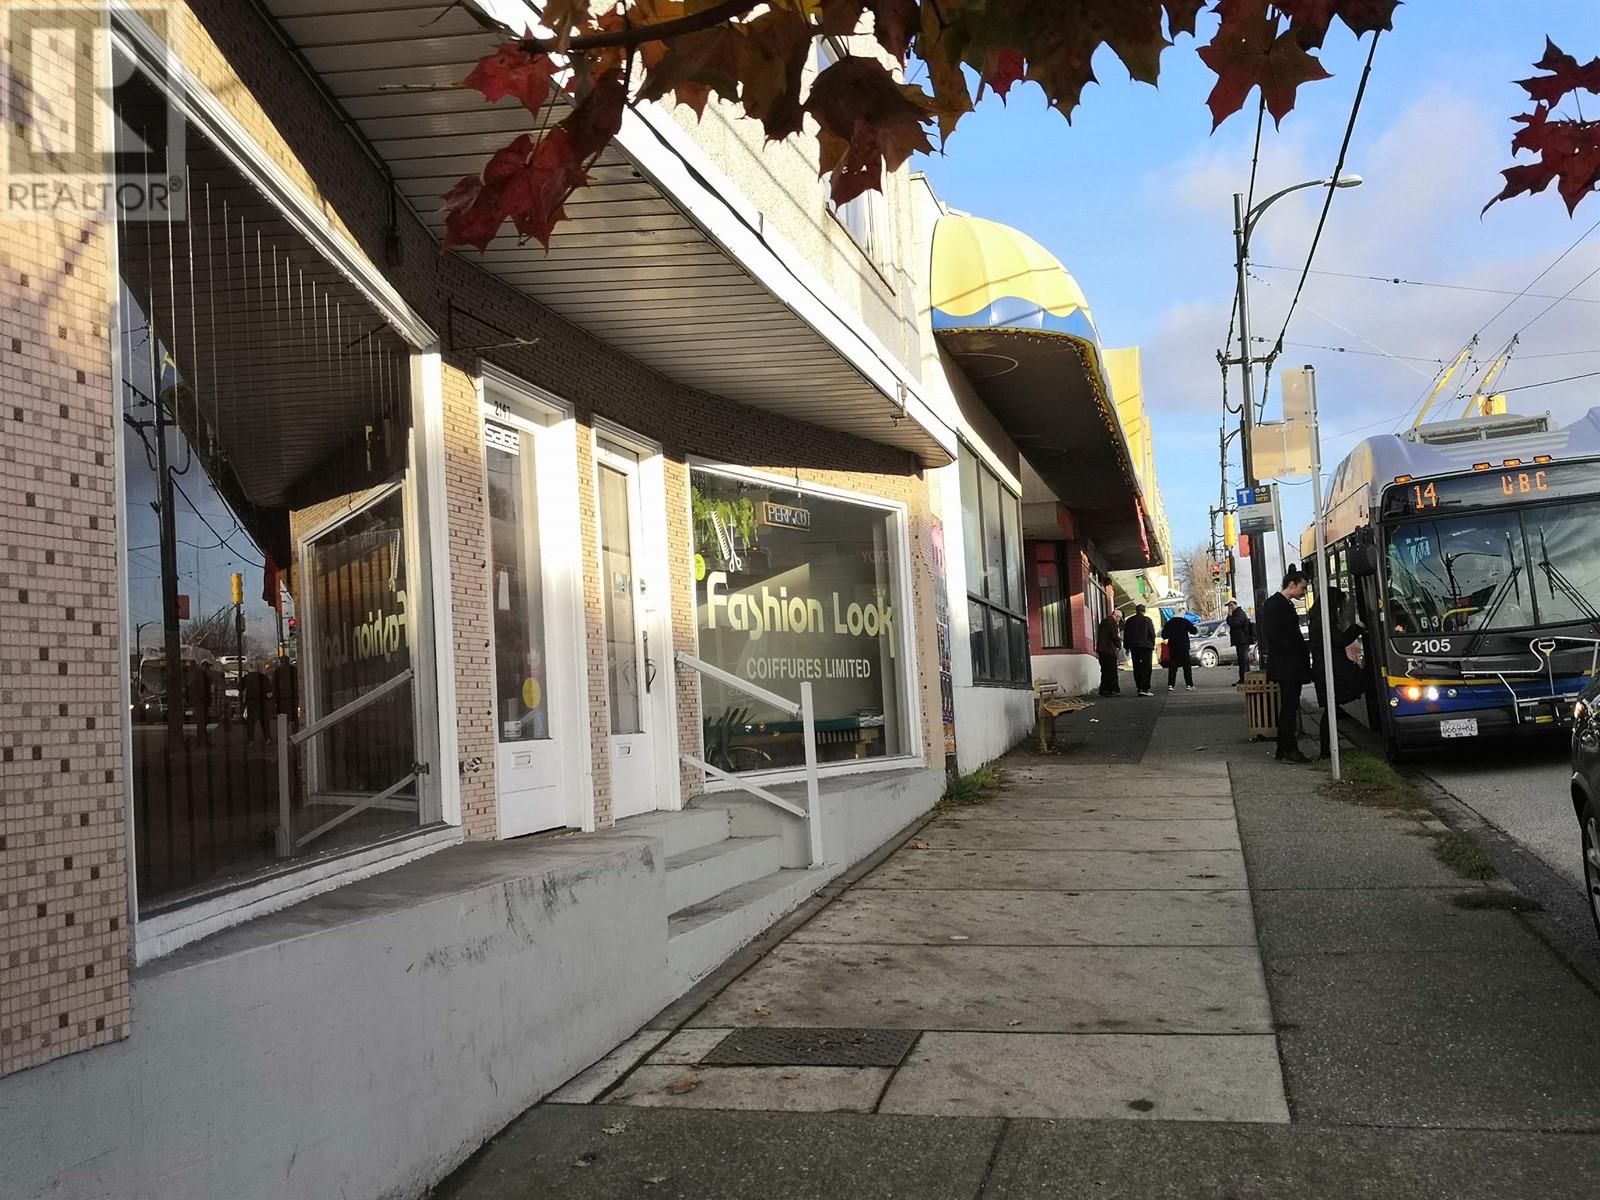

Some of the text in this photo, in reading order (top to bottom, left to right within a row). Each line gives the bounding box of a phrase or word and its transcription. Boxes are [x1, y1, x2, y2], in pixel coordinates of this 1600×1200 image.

[1413, 470, 1548, 509] 14 UBC
[707, 571, 896, 658] Fashion Look
[1412, 638, 1451, 654] 2105
[746, 657, 871, 680] COIFFURES LIMITED
